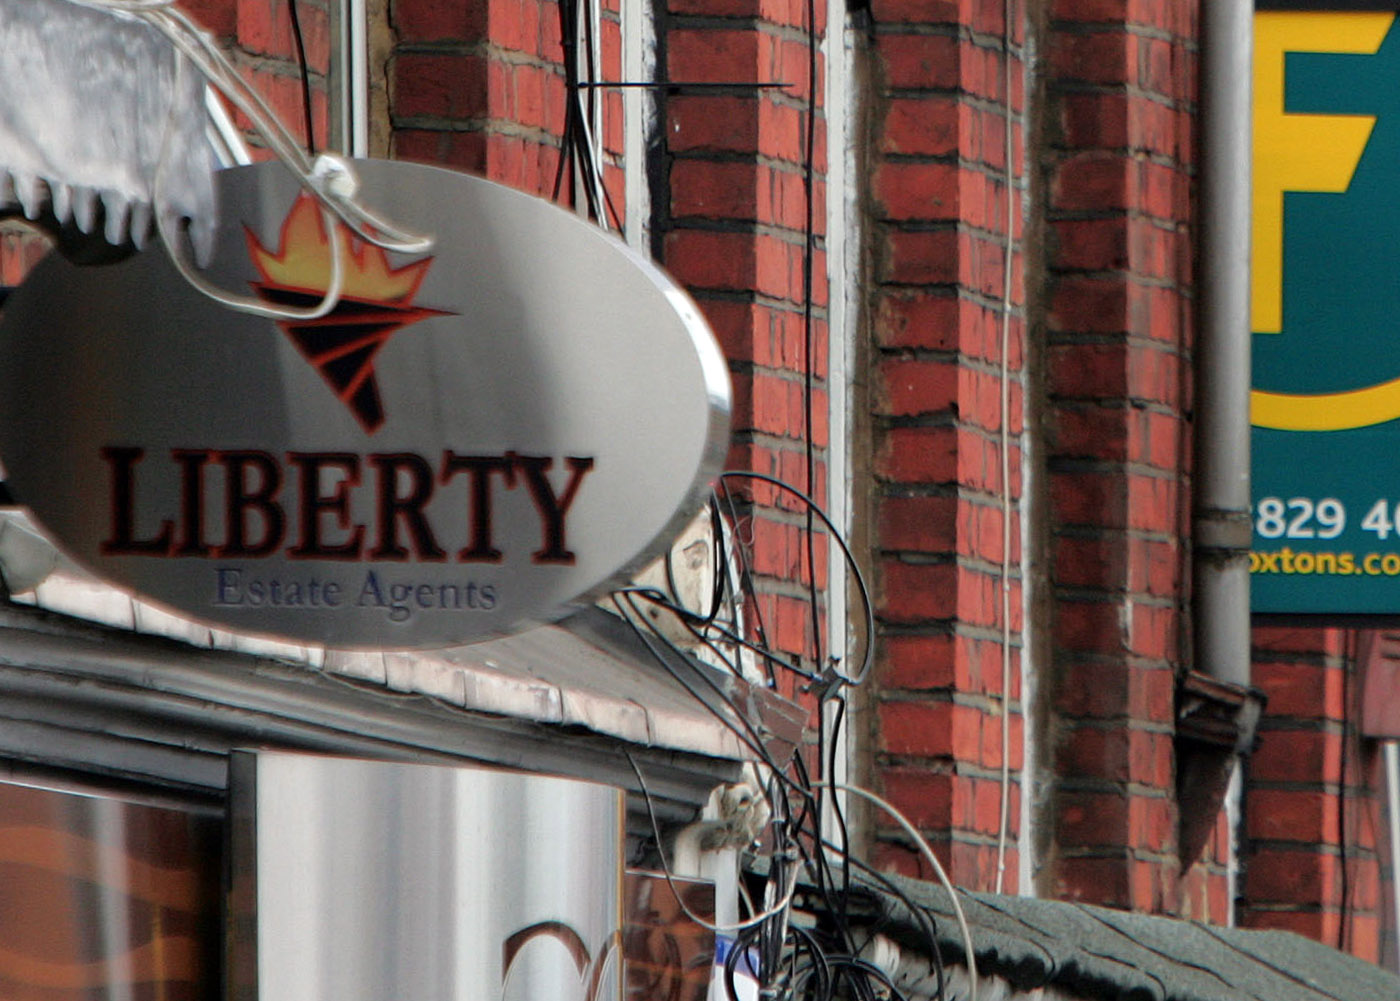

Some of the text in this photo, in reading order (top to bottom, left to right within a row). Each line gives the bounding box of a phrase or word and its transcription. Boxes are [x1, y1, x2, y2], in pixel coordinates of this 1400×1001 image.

[100, 446, 594, 566] LIBERTY
[214, 568, 497, 622] Estate Agents
